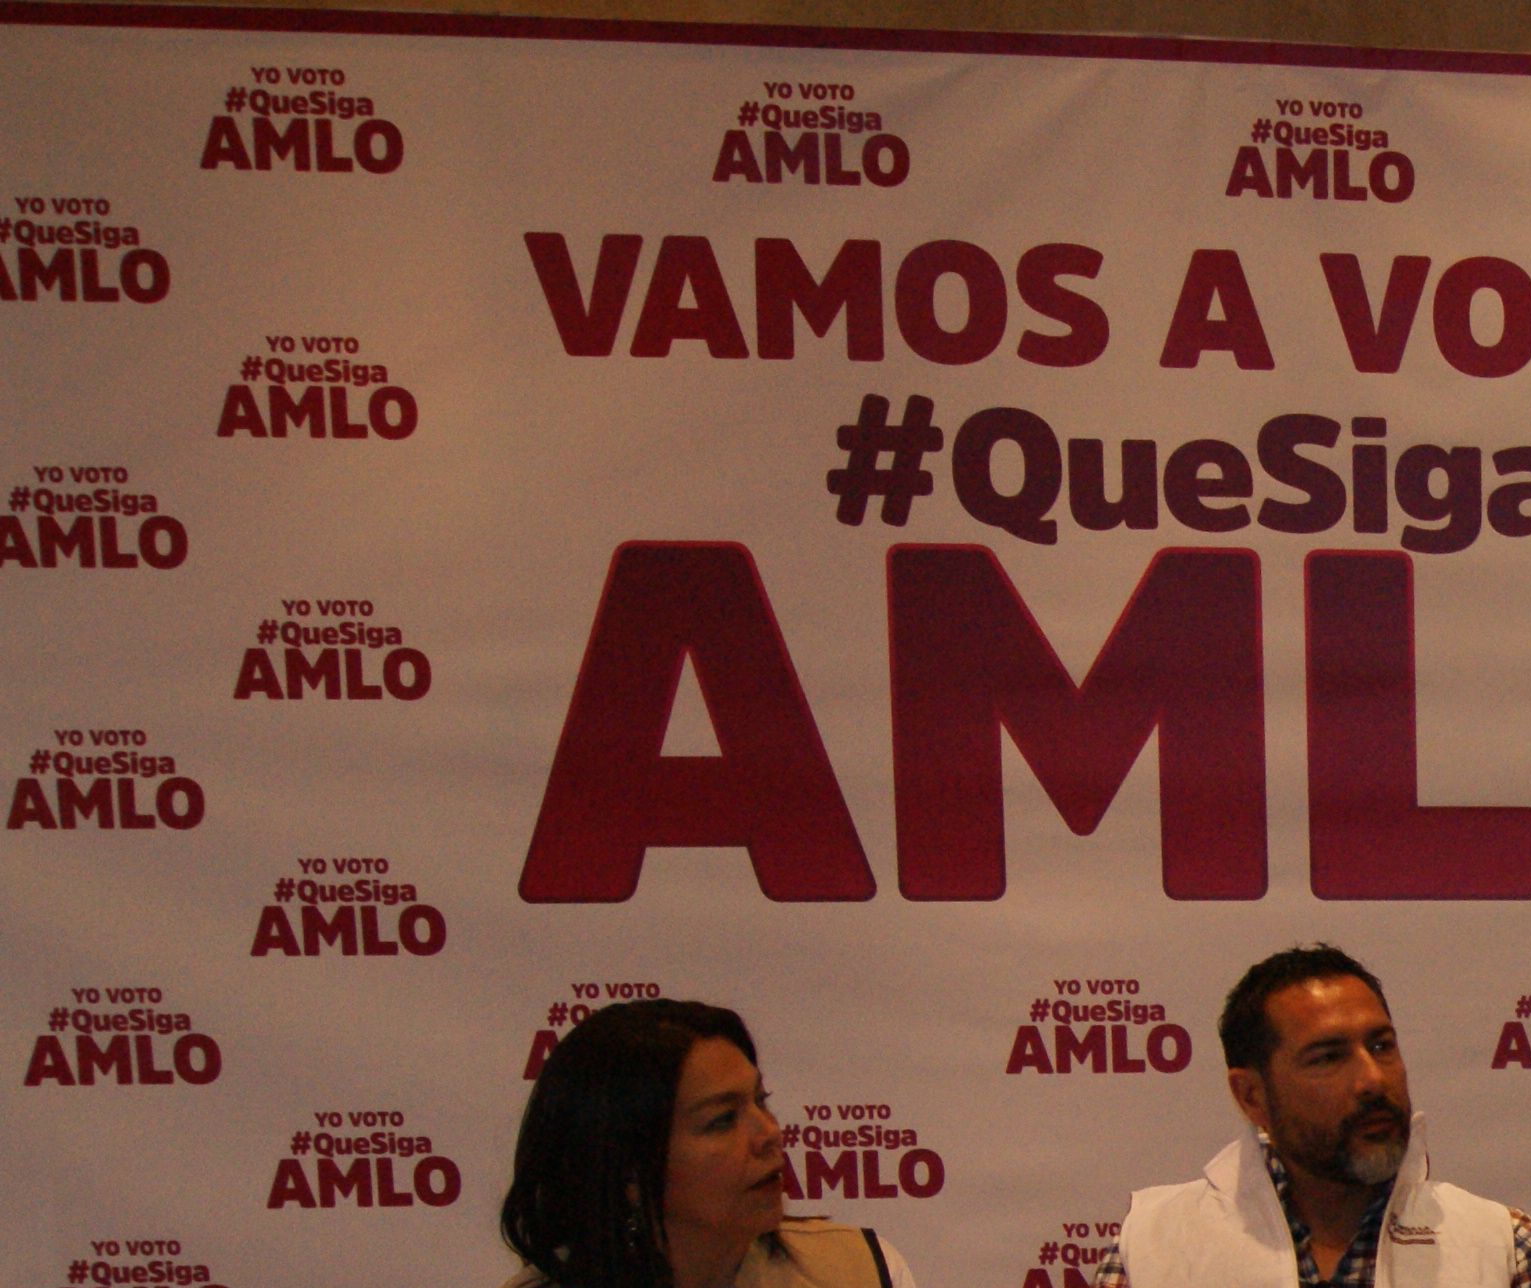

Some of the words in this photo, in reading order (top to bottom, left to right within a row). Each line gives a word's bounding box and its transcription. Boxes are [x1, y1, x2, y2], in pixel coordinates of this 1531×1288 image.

[251, 67, 281, 84] YO
[287, 68, 345, 86] VOTO
[225, 87, 374, 120] #QueSiga
[1276, 100, 1303, 116] YO
[1309, 101, 1363, 119] VOTO
[200, 115, 404, 175] AMLO
[1251, 118, 1389, 151] #QueSiga
[1225, 146, 1415, 203] AMLO
[15, 197, 45, 214] YO
[52, 198, 110, 215] VOTO
[523, 231, 1110, 368] VAMOS
[1159, 249, 1275, 371] A
[266, 336, 296, 353] YO
[301, 337, 359, 354] VOTO
[240, 356, 388, 387] #QueSiga
[216, 384, 418, 440] AMLO
[282, 600, 311, 616] YO
[317, 600, 374, 617] VOTO
[257, 619, 402, 649] #QueSiga
[233, 647, 432, 701] AMLO
[298, 858, 327, 874] YO
[333, 858, 389, 874] VOTO
[274, 878, 417, 906] #QueSiga
[250, 904, 447, 957] AMLO
[1054, 979, 1081, 995] YO
[1087, 979, 1140, 995] VOTO
[1030, 999, 1166, 1025] #QueSiga
[1006, 1023, 1192, 1074] AMLO
[805, 1106, 832, 1121] YO
[839, 1105, 891, 1121] VOTO
[782, 1125, 918, 1149] #QueSiga
[91, 1241, 120, 1256] YO
[125, 1240, 181, 1256] VOTO
[67, 1260, 210, 1286] #QueSiga
